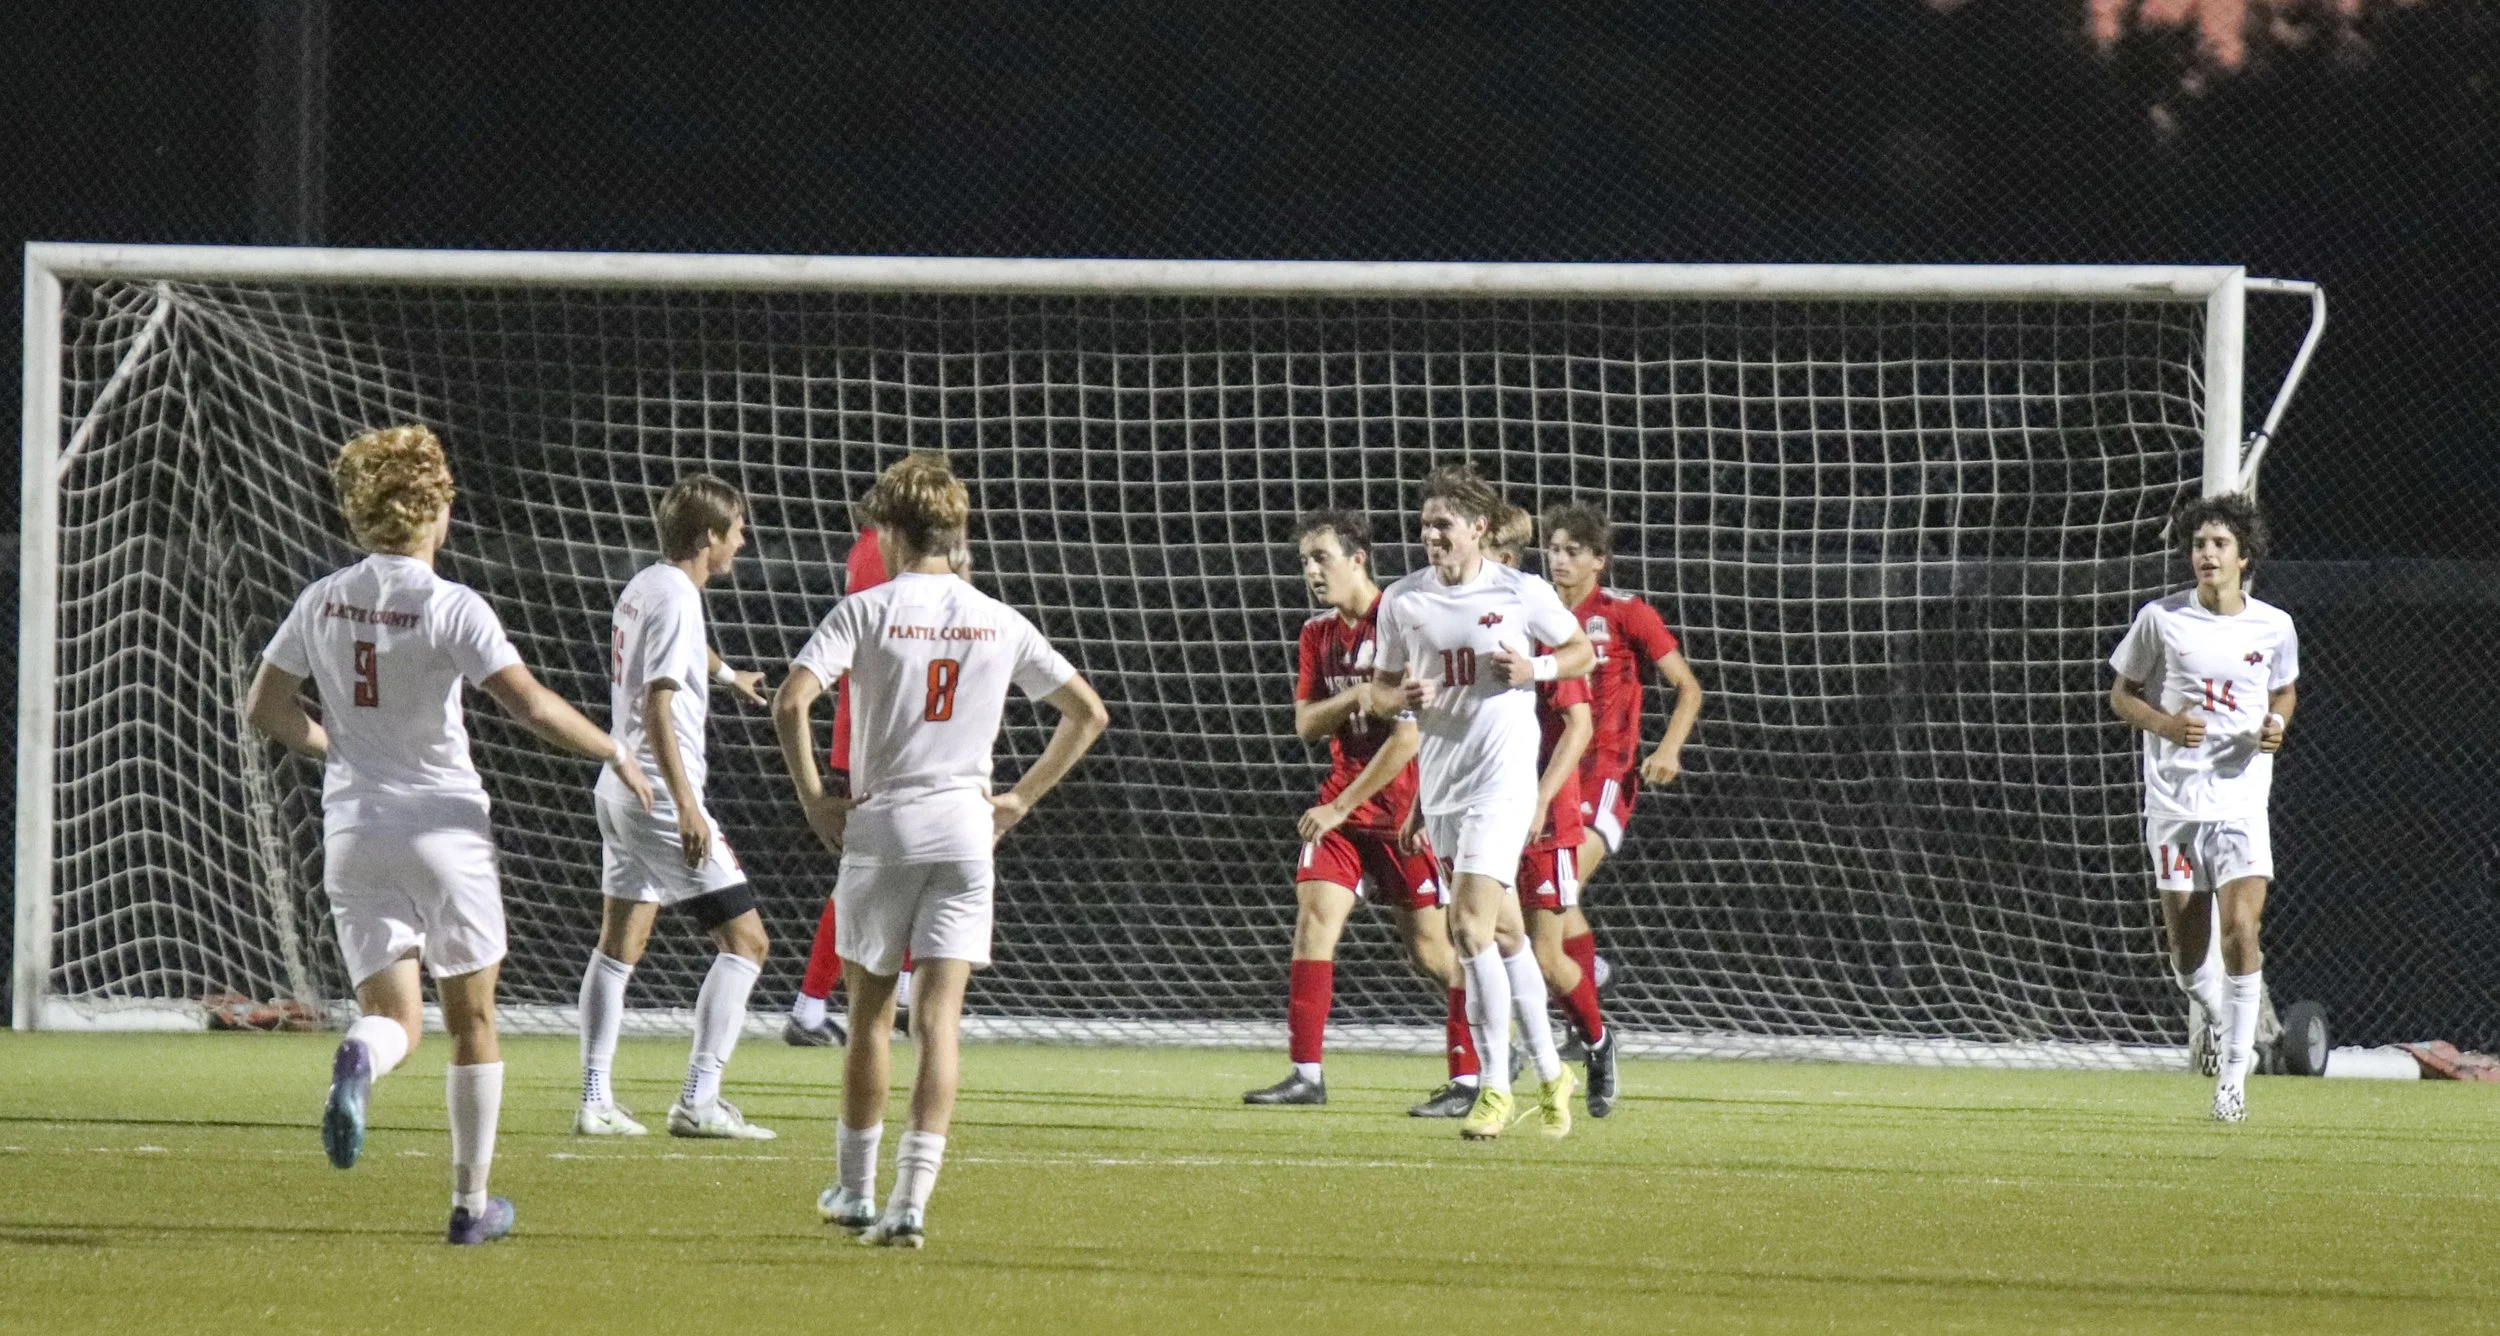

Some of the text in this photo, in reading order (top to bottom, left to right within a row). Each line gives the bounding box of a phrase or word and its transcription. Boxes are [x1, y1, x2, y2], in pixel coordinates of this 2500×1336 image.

[888, 625, 996, 641] PLATTE COUNTY
[354, 640, 379, 707] 9
[1438, 647, 1476, 687] 10
[925, 658, 960, 722] 8
[2202, 678, 2238, 712] 14
[2159, 842, 2194, 880] 14
